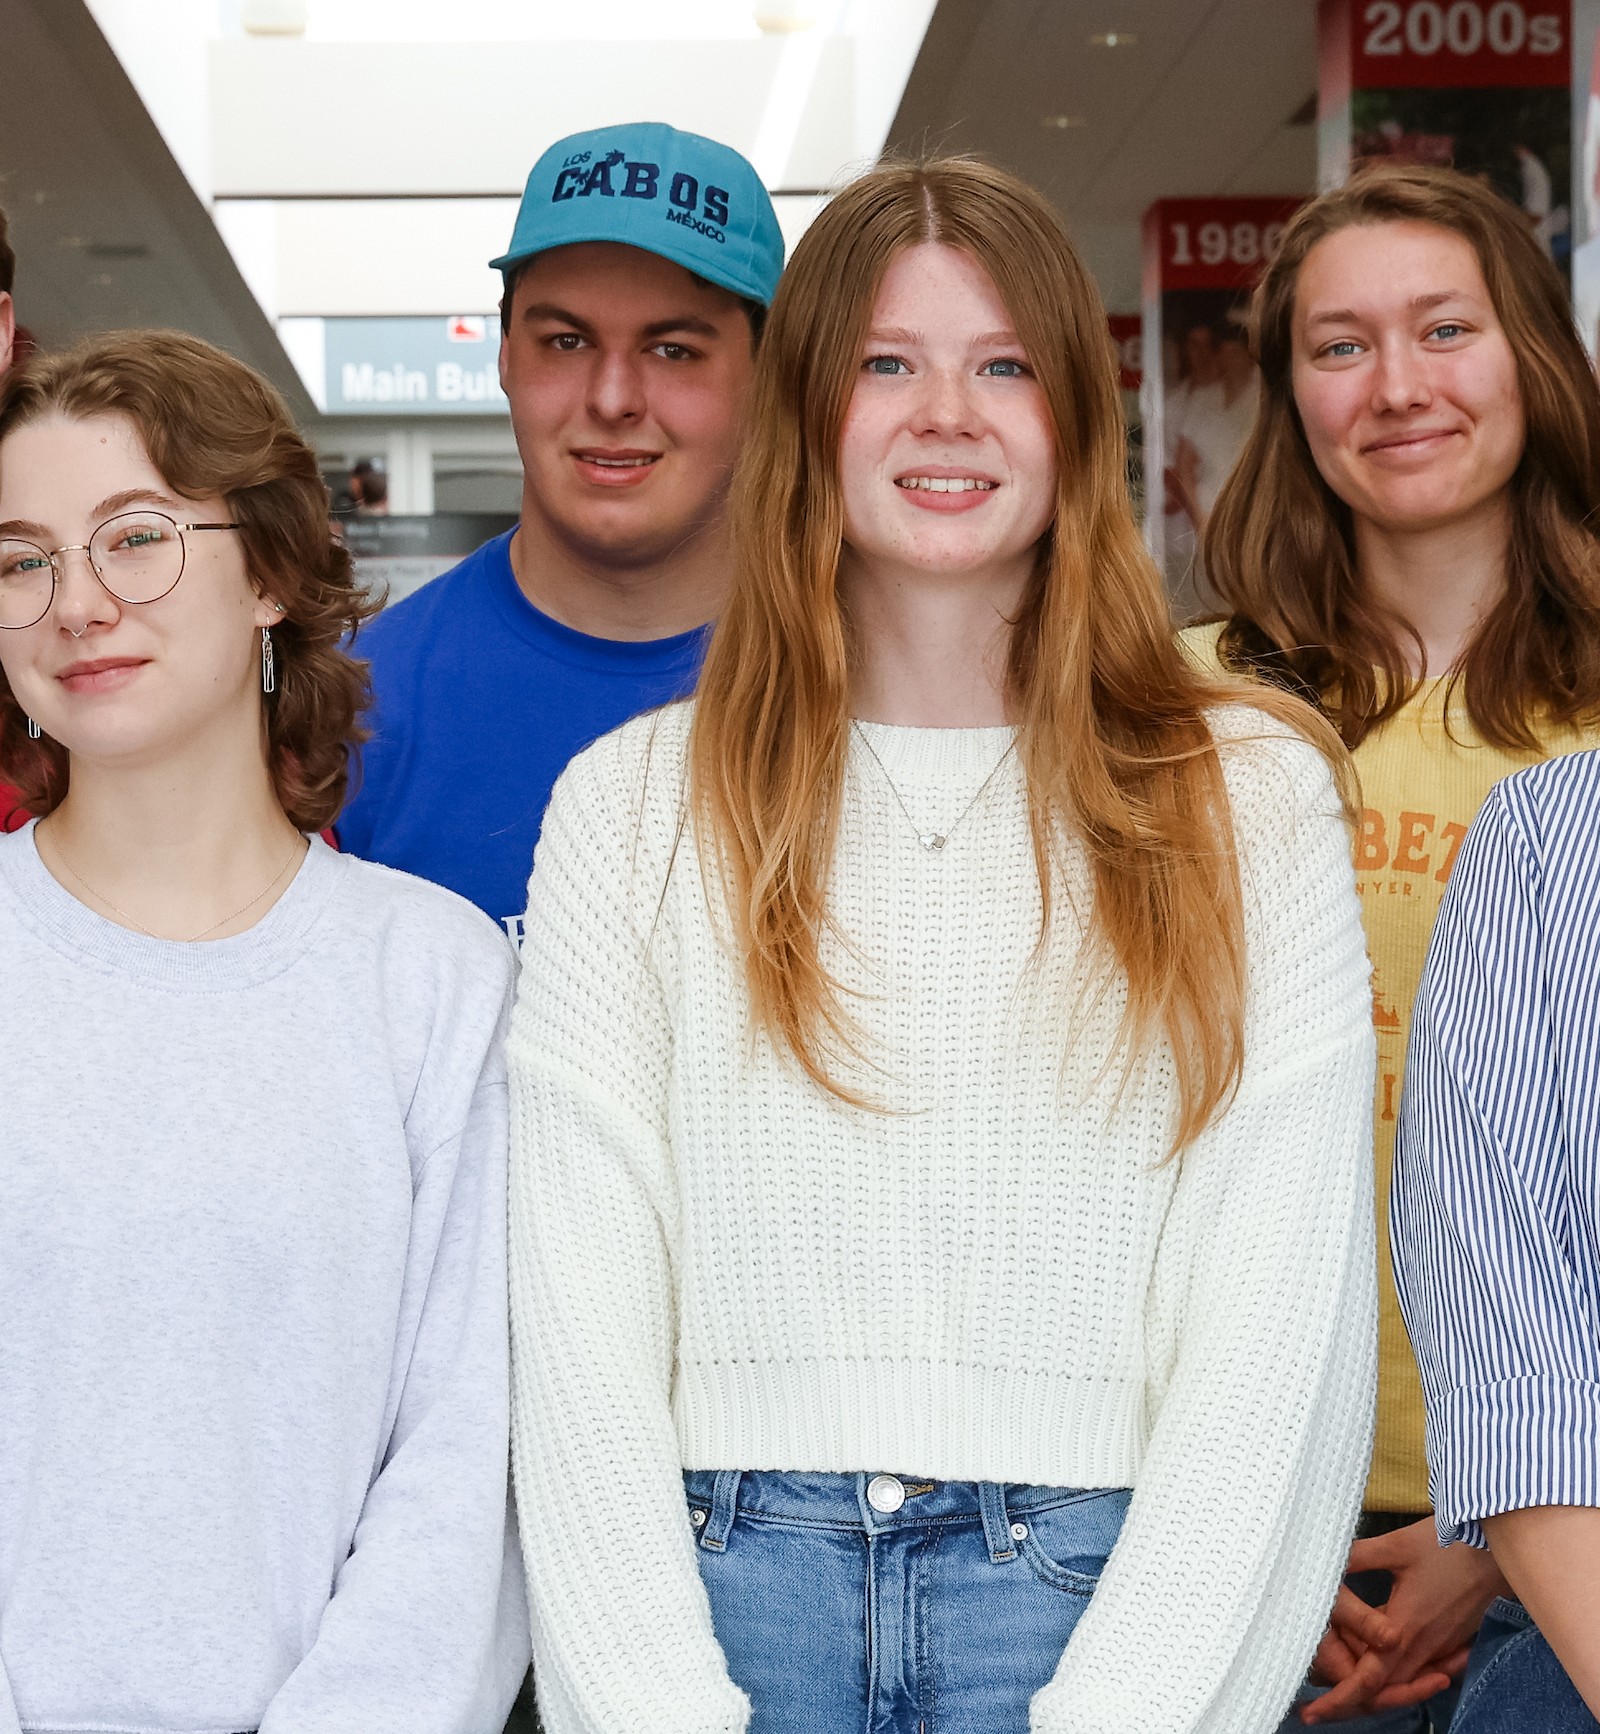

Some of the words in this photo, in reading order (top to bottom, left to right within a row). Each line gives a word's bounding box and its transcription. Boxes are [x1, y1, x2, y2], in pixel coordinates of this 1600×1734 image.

[1364, 0, 1562, 55] 2000s
[563, 151, 592, 168] LOS
[552, 160, 729, 227] CABOS
[1171, 221, 1284, 266] 1980
[342, 362, 429, 400] Main
[436, 362, 501, 400] Bui
